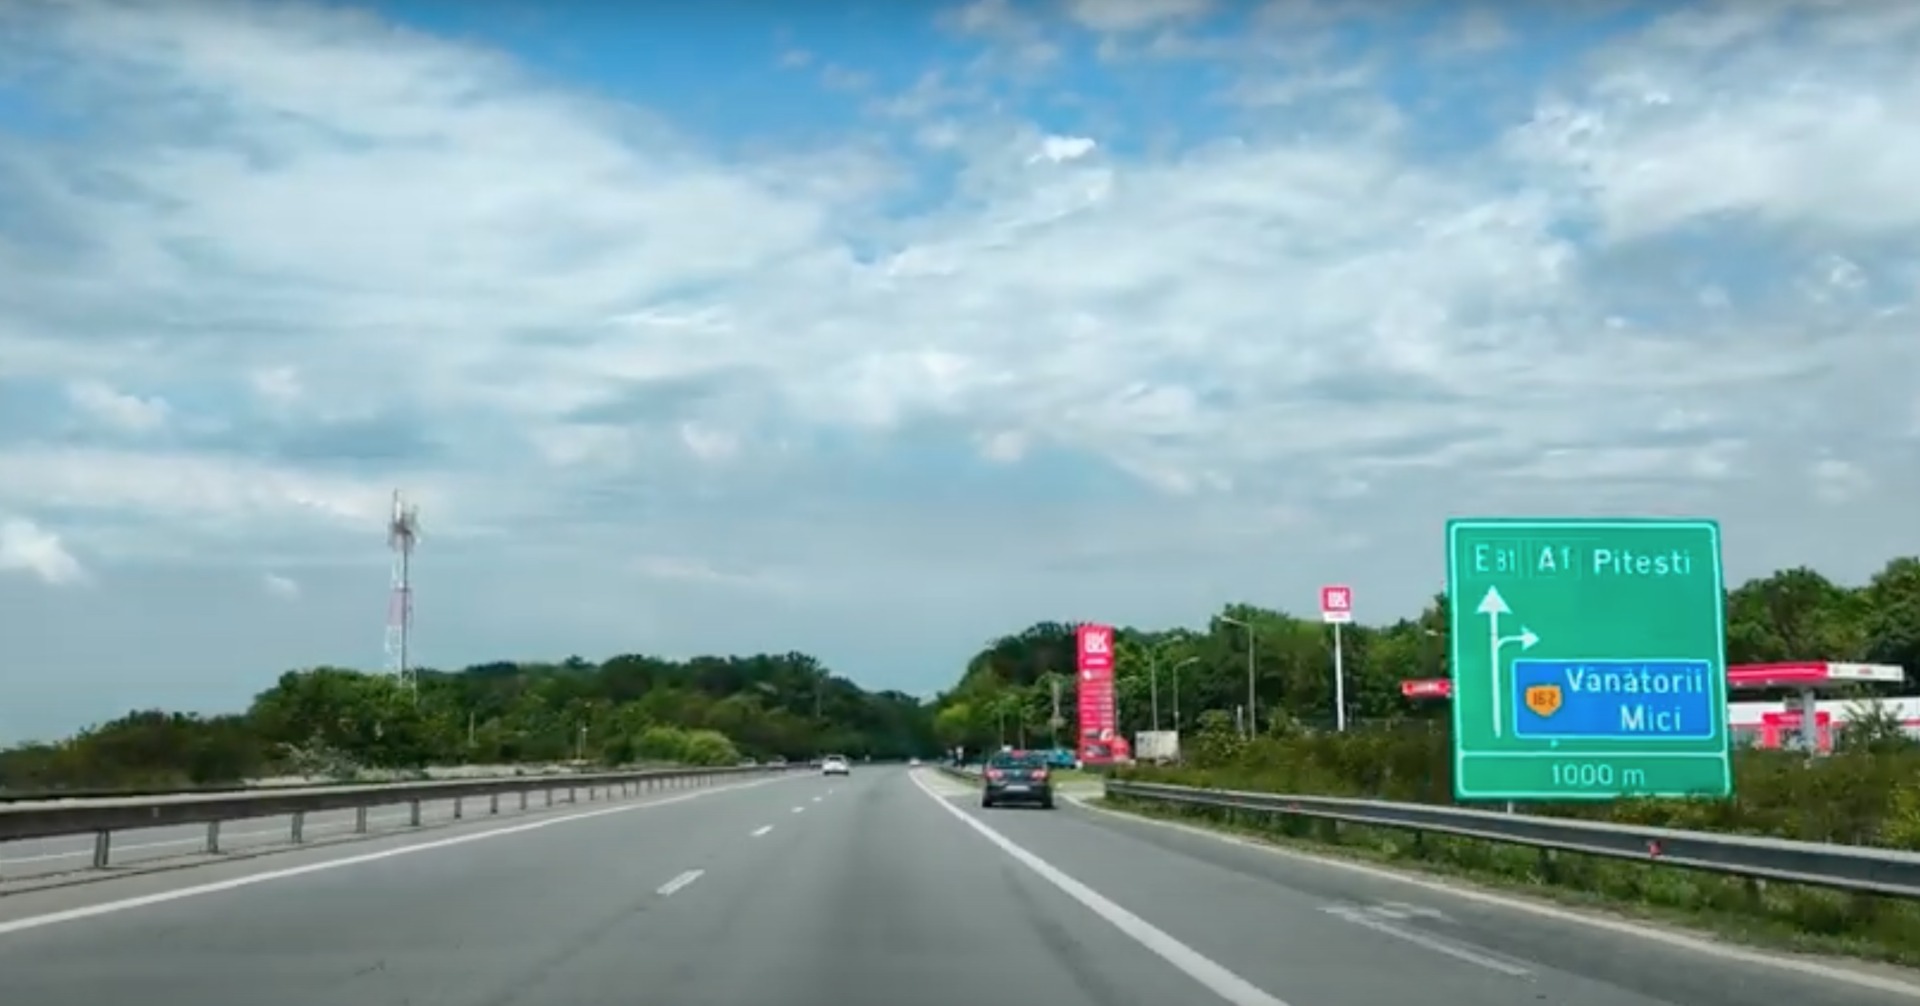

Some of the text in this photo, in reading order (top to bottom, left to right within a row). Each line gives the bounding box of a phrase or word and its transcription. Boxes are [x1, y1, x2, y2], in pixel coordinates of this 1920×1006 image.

[1620, 704, 1682, 732] Mici
[1552, 763, 1646, 787] 1000 m
